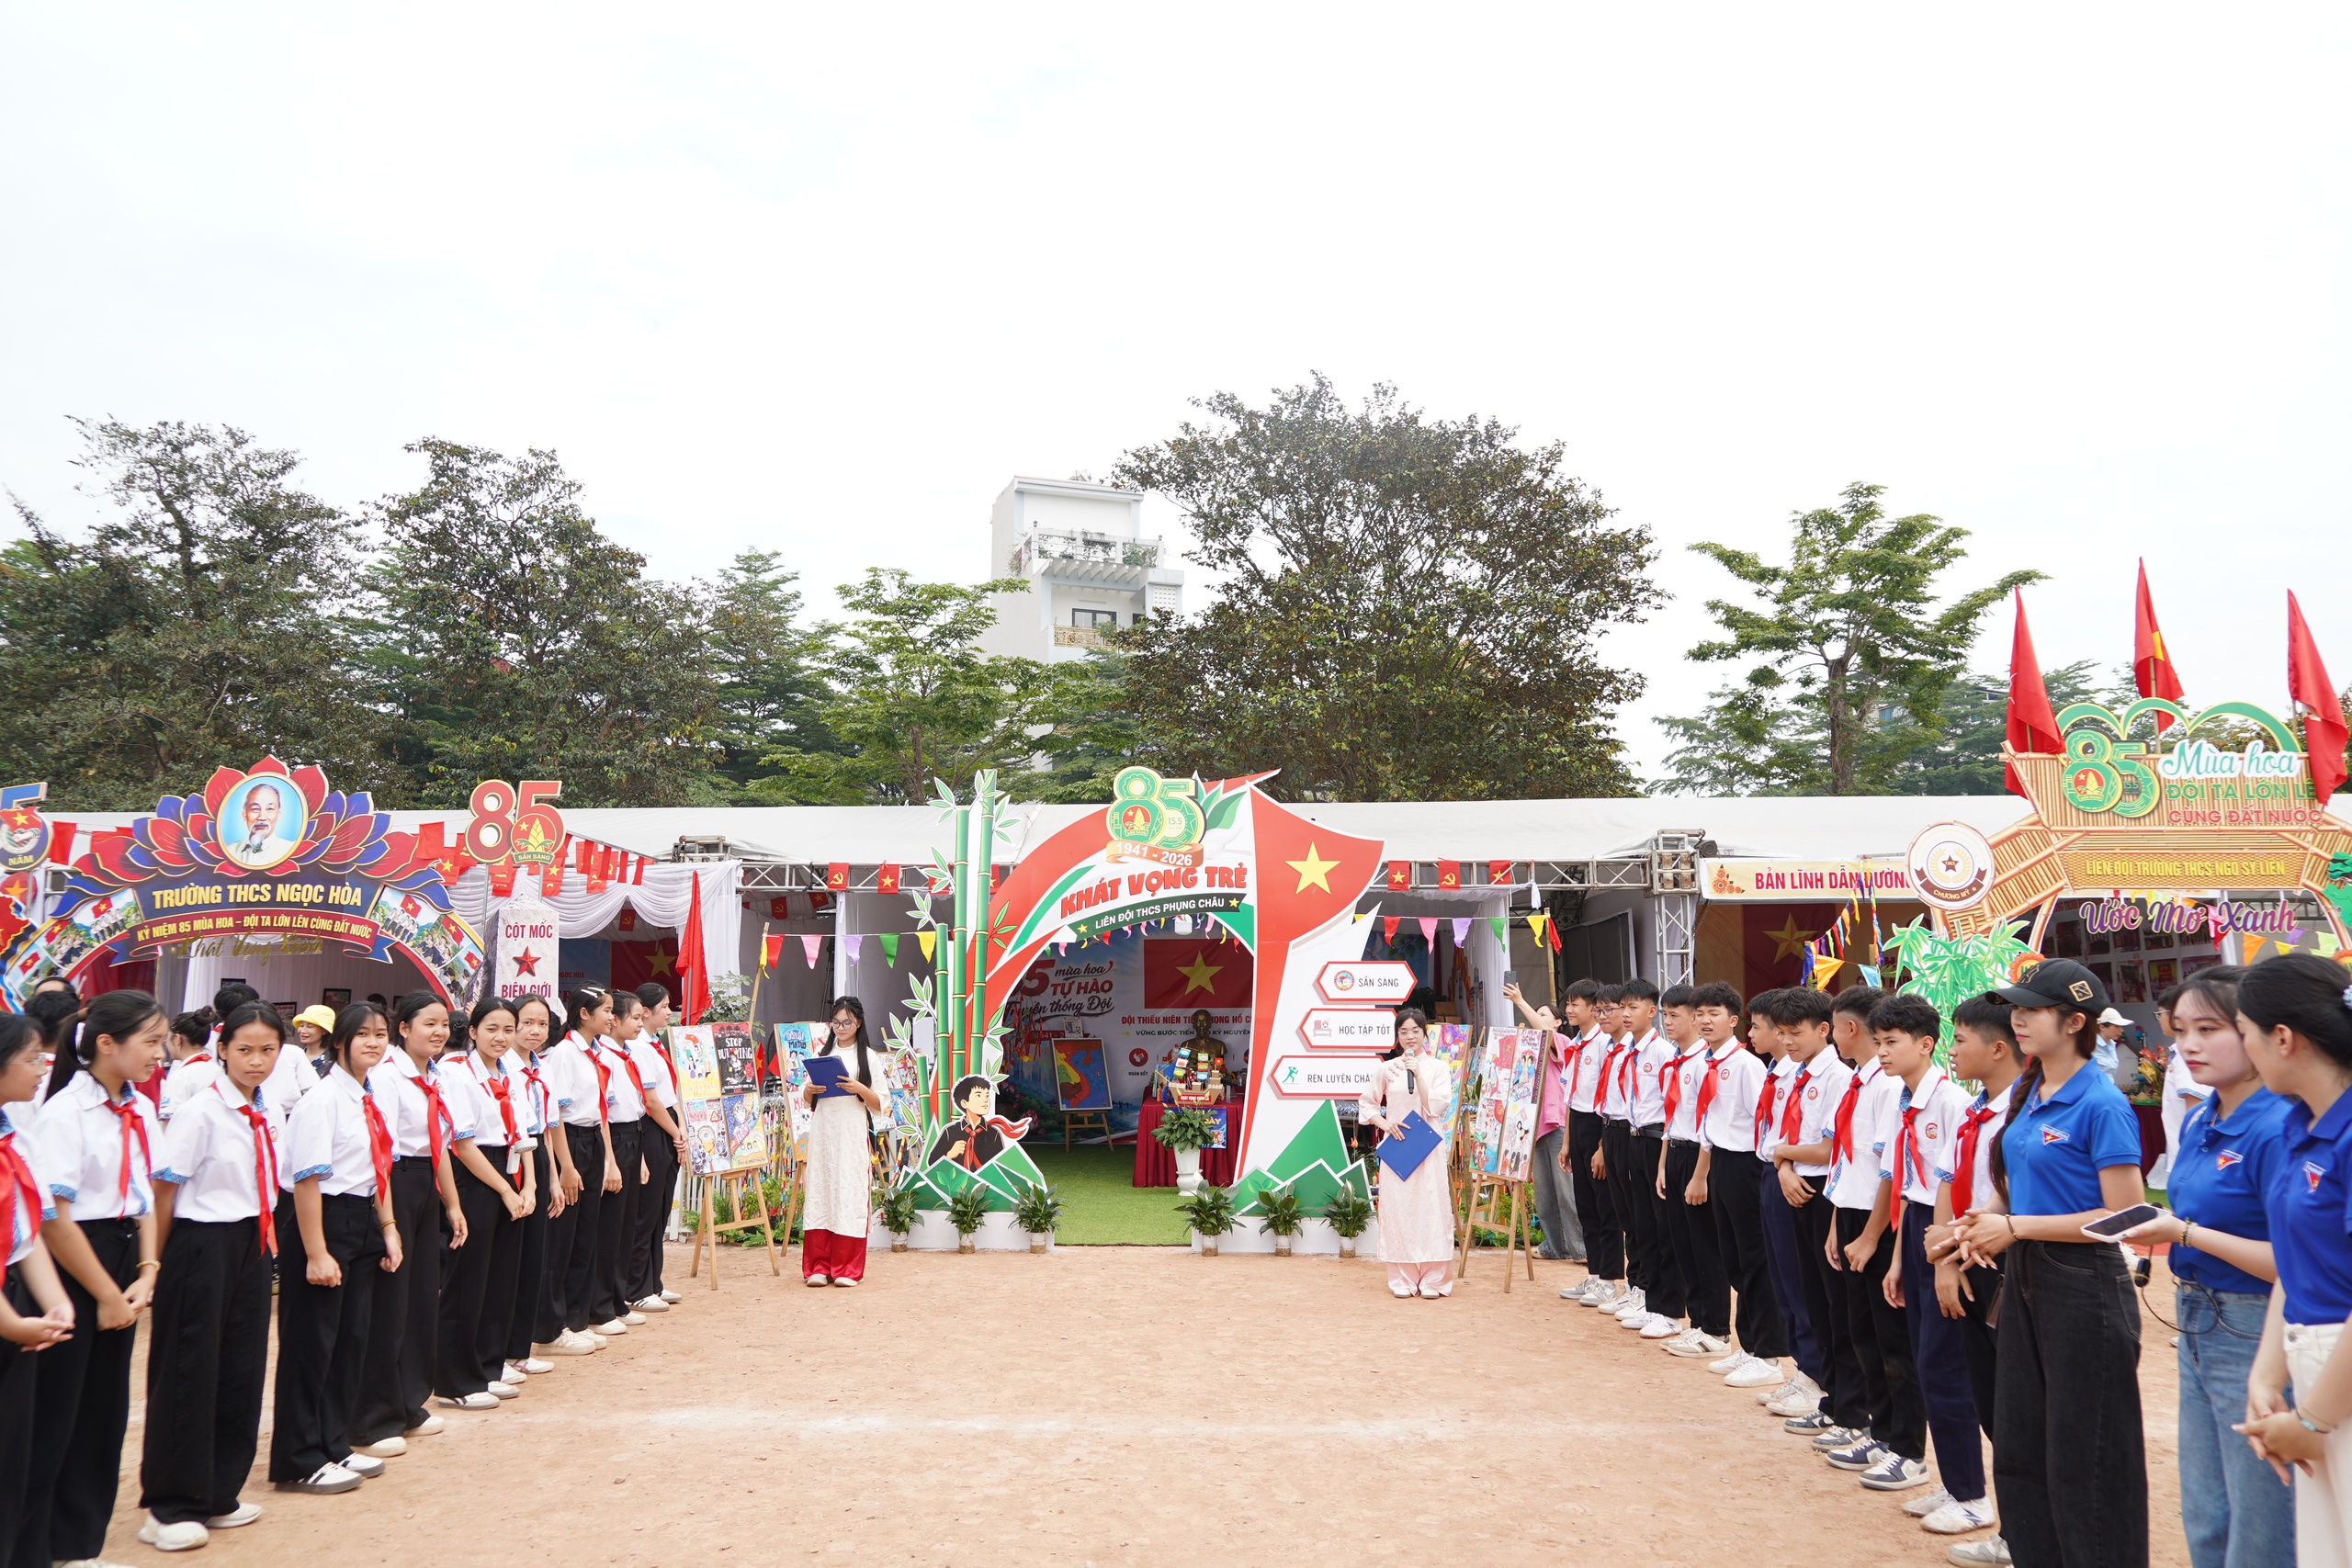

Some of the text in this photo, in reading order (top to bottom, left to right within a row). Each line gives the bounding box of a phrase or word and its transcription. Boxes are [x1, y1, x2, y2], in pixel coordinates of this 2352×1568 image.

[2162, 741, 2296, 776] Mùa hoa
[2061, 728, 2160, 818] 85
[2166, 778, 2316, 804] ĐỘI TA LỚN LÊ
[1105, 765, 1206, 851] 85
[2168, 805, 2323, 823] CÙNG ĐẤT NƯỚC
[464, 779, 567, 864] 85
[1168, 817, 1182, 825] 15.5
[8, 854, 34, 866] NĂM
[1116, 841, 1148, 857] 1941
[1159, 851, 1193, 866] 2026
[1755, 865, 1911, 890] BẢN LĨNH DẪN ĐƯỜN
[2086, 860, 2111, 875] LIÊN
[2113, 859, 2132, 879] ĐỘI
[2135, 858, 2181, 876] TRƯỜNG
[2182, 861, 2212, 876] THCS
[2214, 858, 2239, 876] NGÔ
[2259, 858, 2286, 875] LIÊN
[152, 882, 362, 909] TRƯỜNG THCS NGỌC HÒA
[1060, 862, 1248, 919] KHÁT VỌNG TRẺ
[1095, 896, 1225, 930] LIÊN ĐỘI THCS PHỤNG CHÂU
[2079, 898, 2298, 934] Ước Mơ Xanh
[152, 922, 177, 938] NIỆM
[178, 920, 191, 933] 85
[193, 917, 214, 931] MÙA
[215, 917, 233, 929] HOA
[243, 914, 259, 929] ĐỘI
[261, 916, 271, 927] TA
[273, 914, 291, 928] LỚN
[292, 914, 308, 929] LÊN
[310, 916, 332, 931] CÙNG
[334, 919, 350, 933] ĐẤT
[349, 923, 372, 939] NƯỚC
[504, 919, 553, 942] CỘT MỐC
[1055, 965, 1082, 976] mùa
[1084, 962, 1107, 975] hoa
[501, 982, 526, 998] BIÊN
[529, 980, 551, 998] GIỚI
[1050, 978, 1114, 998] TỰ HÀO
[1377, 976, 1399, 987] SÀNG
[1049, 998, 1085, 1017] thống
[1087, 995, 1114, 1011] Đội
[1121, 1015, 1135, 1026] ĐỘI
[1137, 1014, 1160, 1024] THIẾU
[1163, 1015, 1181, 1024] NIÊN
[1210, 1016, 1229, 1024] HONG
[1339, 1024, 1390, 1037] HỌC TẬP TỐT
[725, 1037, 743, 1047] STOP
[1307, 1073, 1323, 1083] RÈN
[1326, 1073, 1351, 1085] LUYỆN
